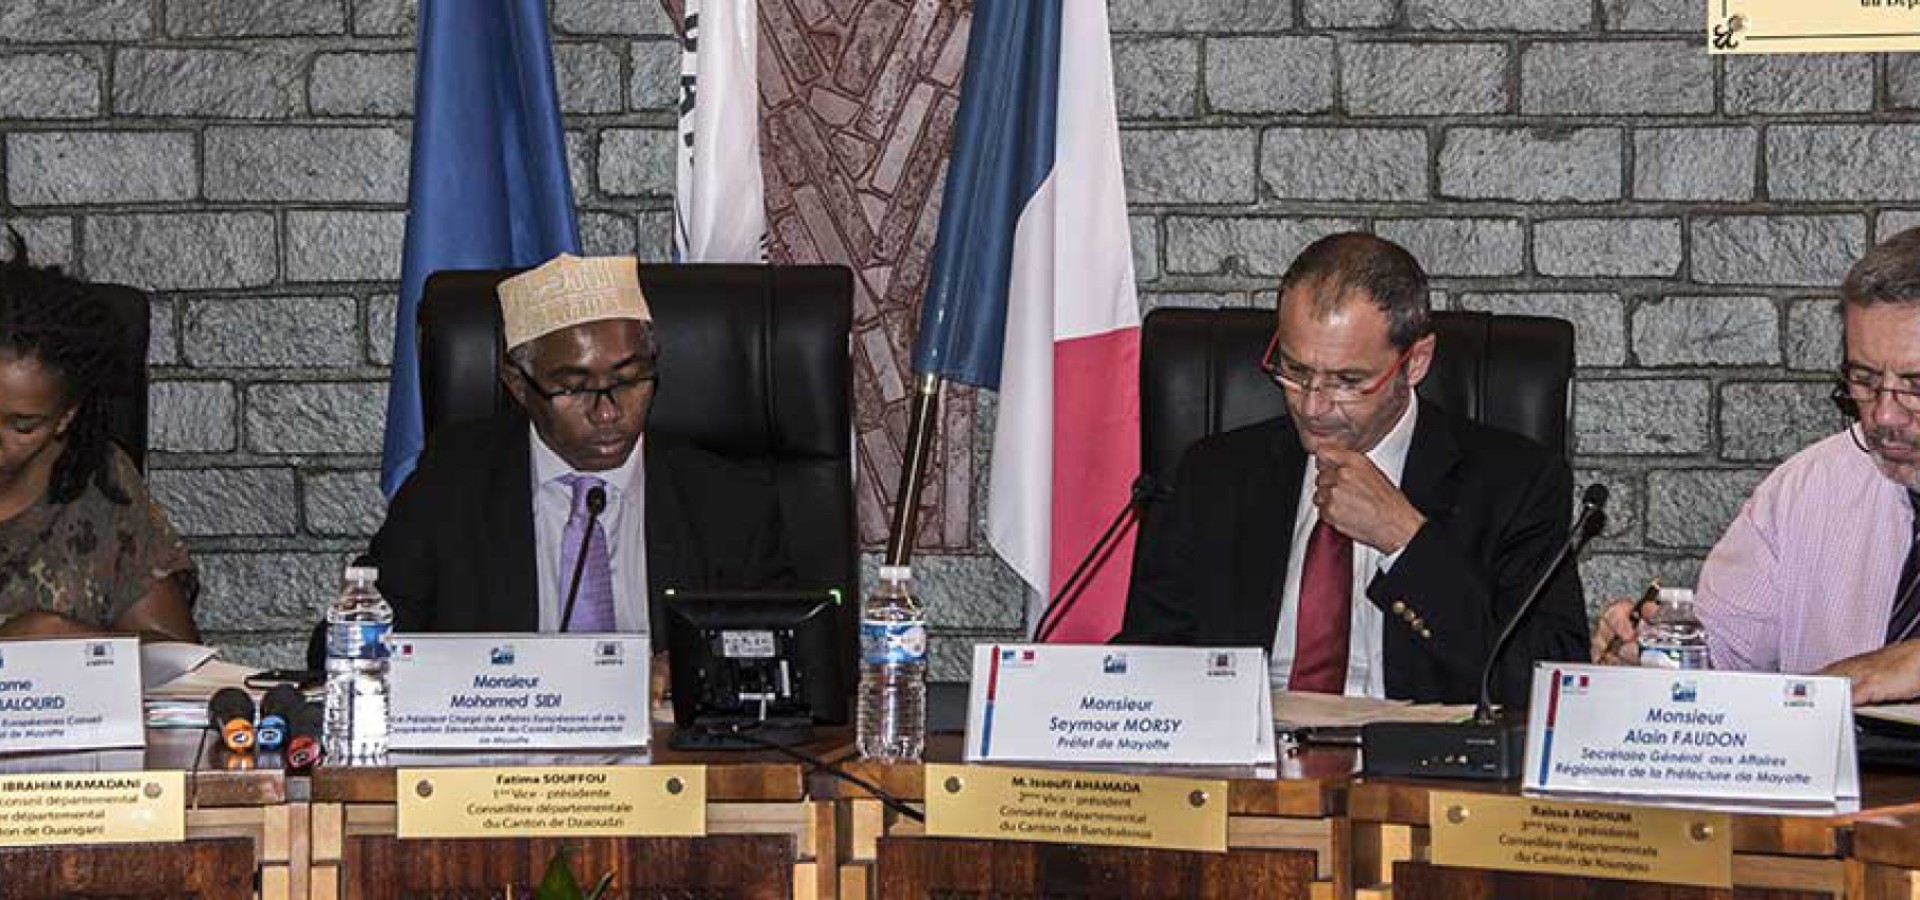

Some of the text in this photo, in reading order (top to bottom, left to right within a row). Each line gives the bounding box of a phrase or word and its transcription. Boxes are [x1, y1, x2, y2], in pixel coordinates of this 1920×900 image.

[473, 675, 539, 688] Monsieur
[451, 693, 562, 708] Mohamed SIDI
[1080, 697, 1153, 711] Monsieur
[1646, 708, 1725, 725] Monsieur
[1049, 716, 1182, 734] Seymour MORSY
[1097, 738, 1113, 749] de
[1118, 738, 1170, 752] Mayotte
[1623, 729, 1748, 748] Alain FAUDON
[1649, 749, 1703, 763] Général
[1708, 755, 1734, 765] aux
[1737, 755, 1787, 767] Affaires
[496, 773, 607, 784] Fatima SOUFFOU
[1555, 763, 1812, 785] Régionales de la Préfecture de Mayotte
[65, 779, 141, 790] RAMADANI
[1074, 780, 1141, 793] AHAMADA
[512, 789, 537, 799] Vice
[483, 817, 500, 828] du
[502, 817, 546, 828] Canton
[548, 817, 565, 827] de
[23, 827, 39, 835] de
